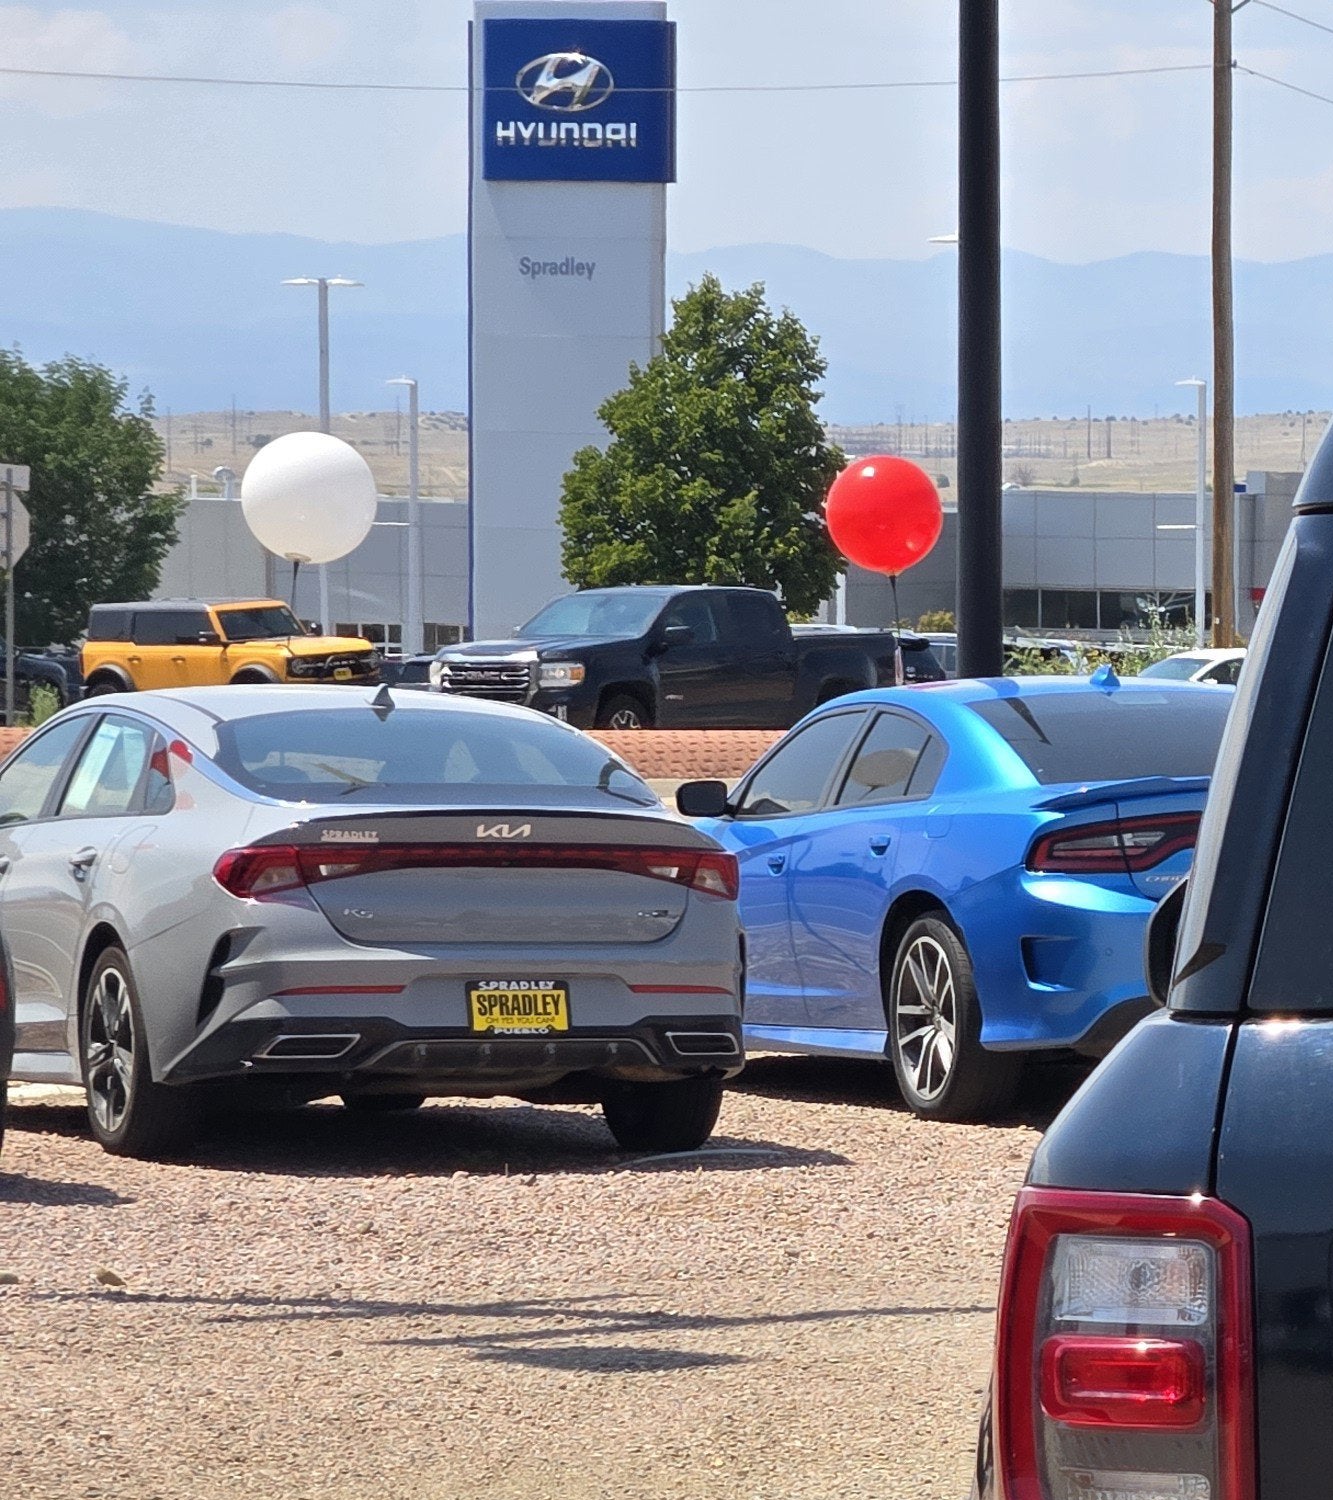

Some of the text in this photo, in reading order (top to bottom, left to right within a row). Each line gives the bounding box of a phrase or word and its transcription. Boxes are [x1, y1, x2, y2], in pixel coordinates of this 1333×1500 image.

[496, 121, 637, 148] HYUNDAI
[519, 256, 596, 281] Spradley
[321, 829, 378, 839] SPRADLEY
[478, 980, 555, 991] SPRADLEY
[476, 994, 561, 1016] SPRADLEY
